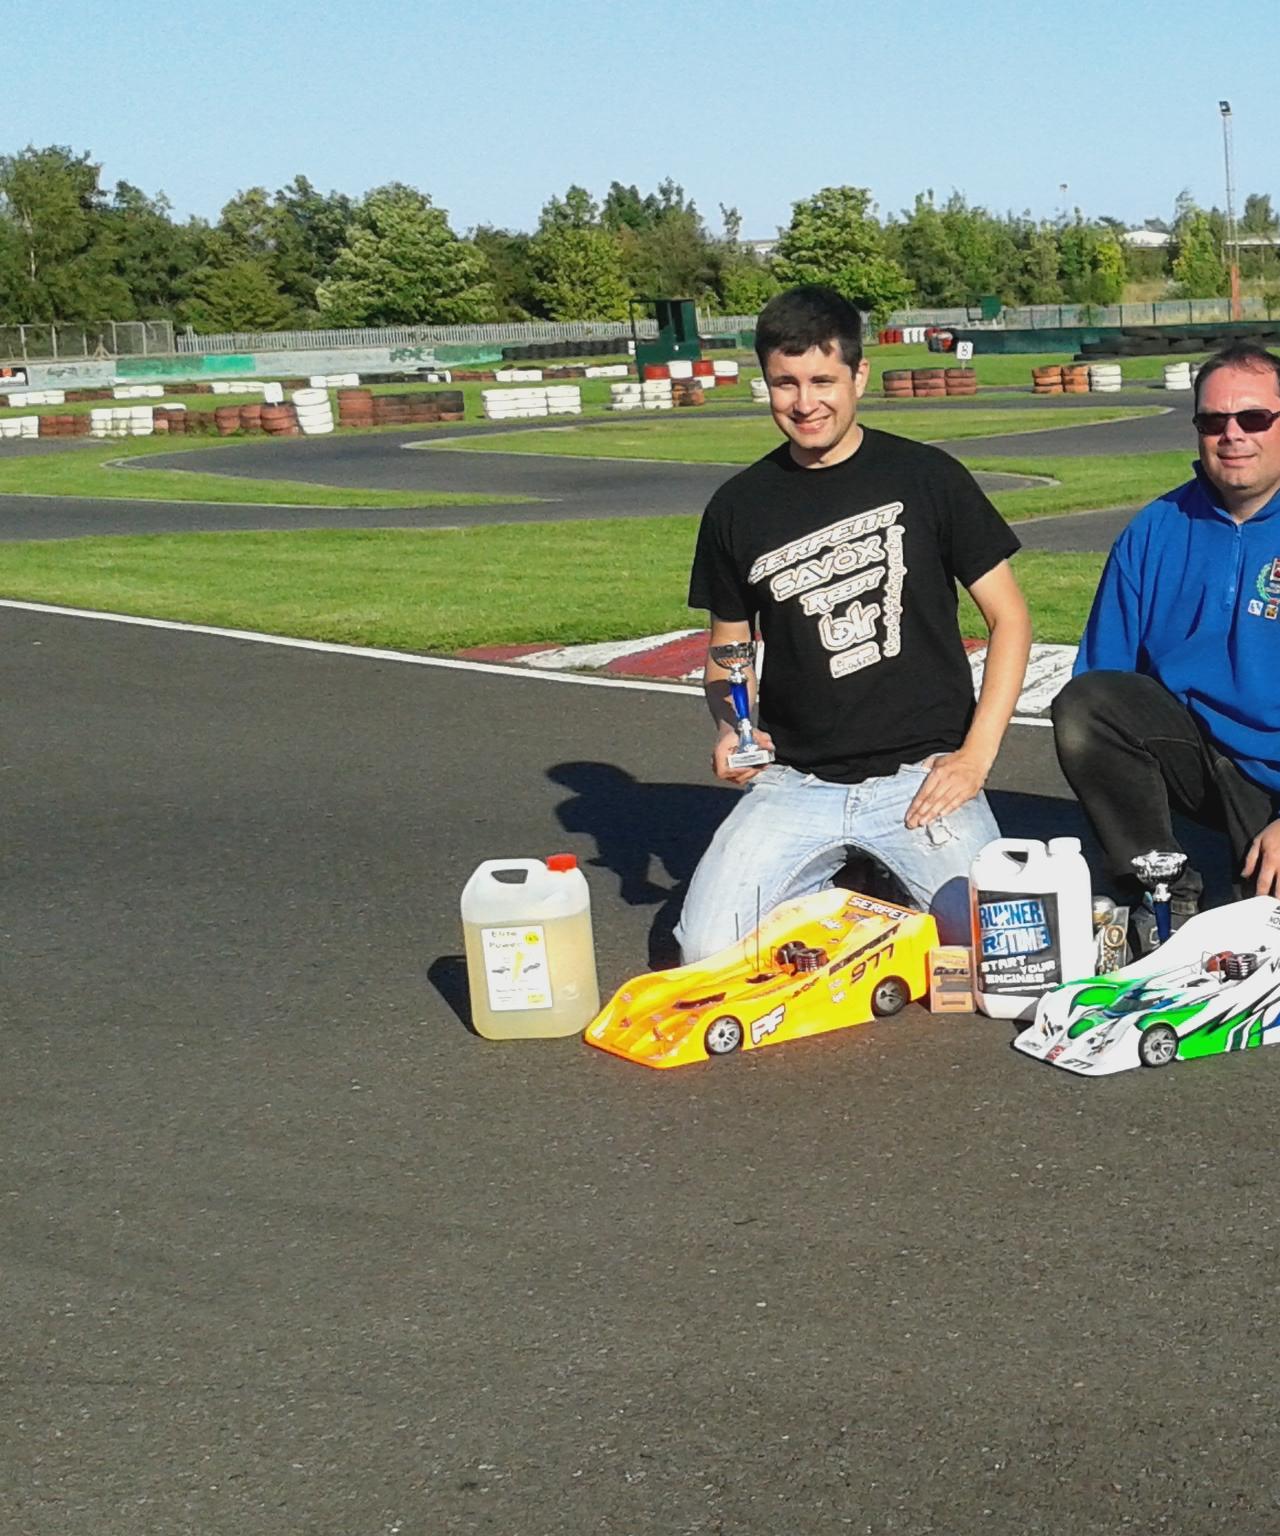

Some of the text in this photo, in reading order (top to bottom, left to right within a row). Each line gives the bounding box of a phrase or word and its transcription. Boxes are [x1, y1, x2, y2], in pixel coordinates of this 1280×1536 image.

[748, 502, 904, 584] SERPENT
[978, 901, 1043, 928] RUNNER
[850, 943, 894, 985] 977
[981, 955, 1026, 973] START
[1020, 960, 1056, 975] YOUR
[985, 973, 1045, 984] ENGINES
